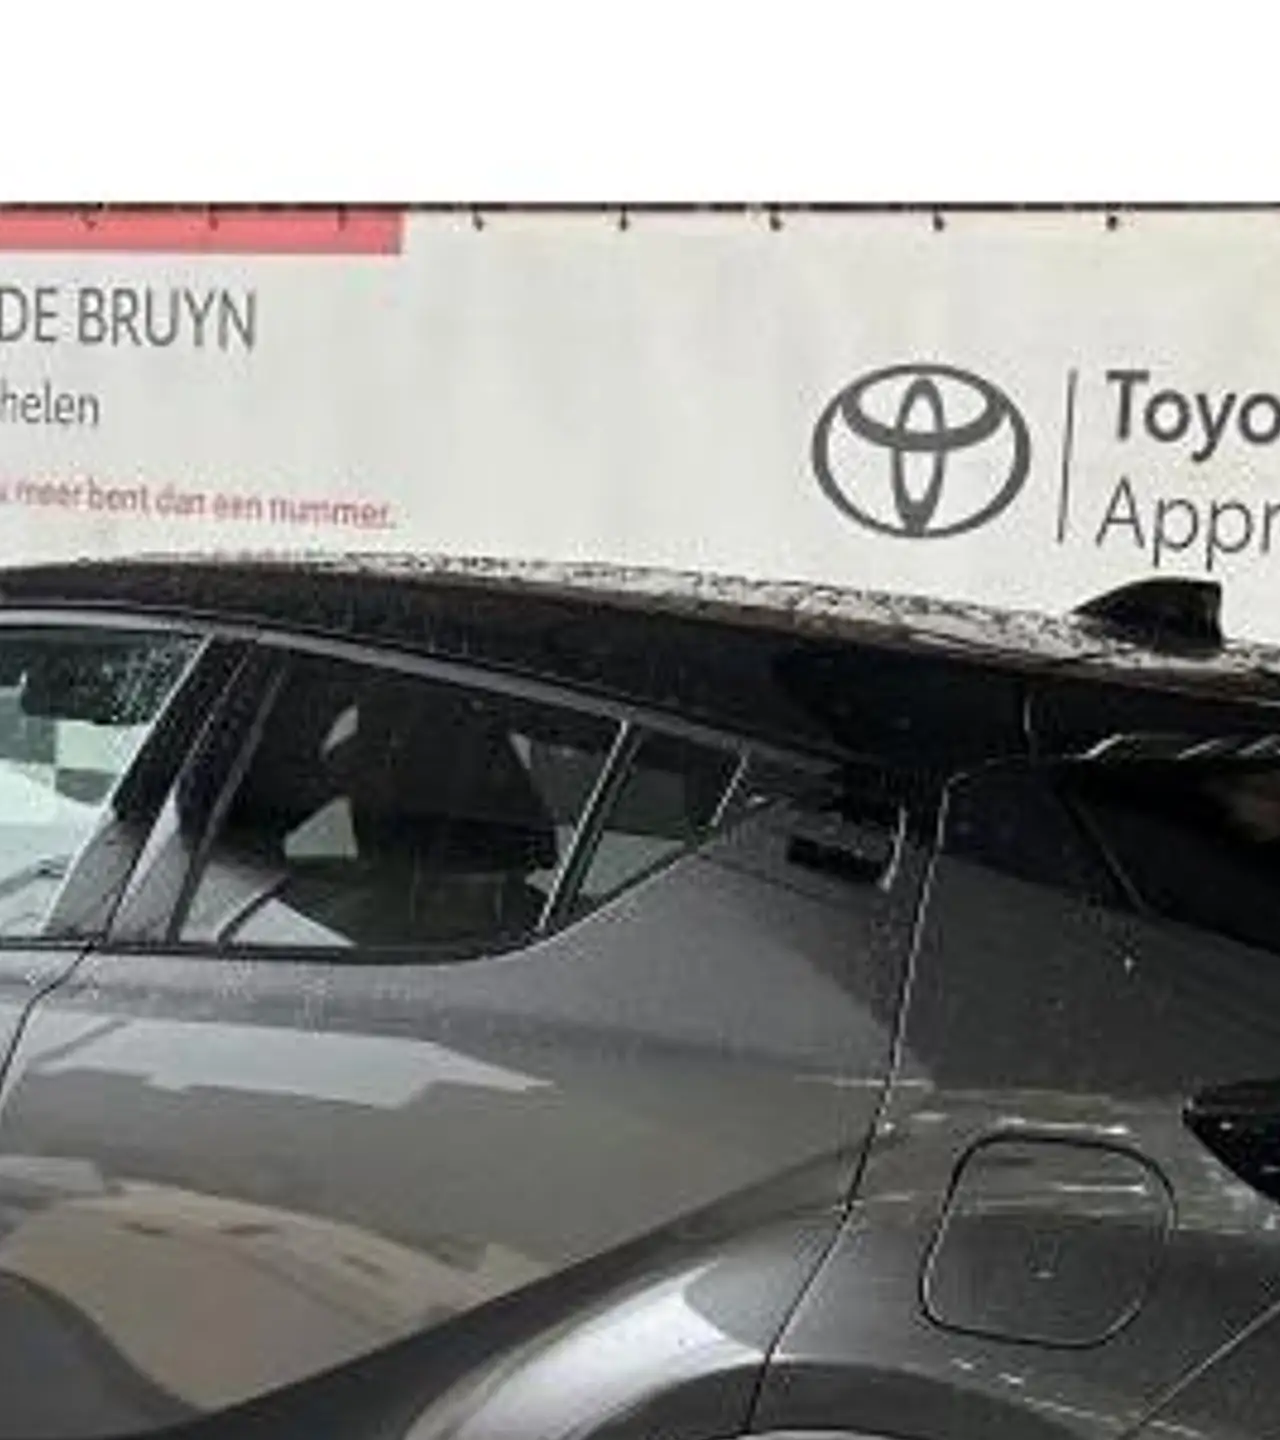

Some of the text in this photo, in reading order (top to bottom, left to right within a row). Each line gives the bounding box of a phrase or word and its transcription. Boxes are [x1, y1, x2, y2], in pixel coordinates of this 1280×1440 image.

[77, 287, 258, 352] BRUYN
[88, 478, 150, 514] bent
[156, 483, 208, 516] dan
